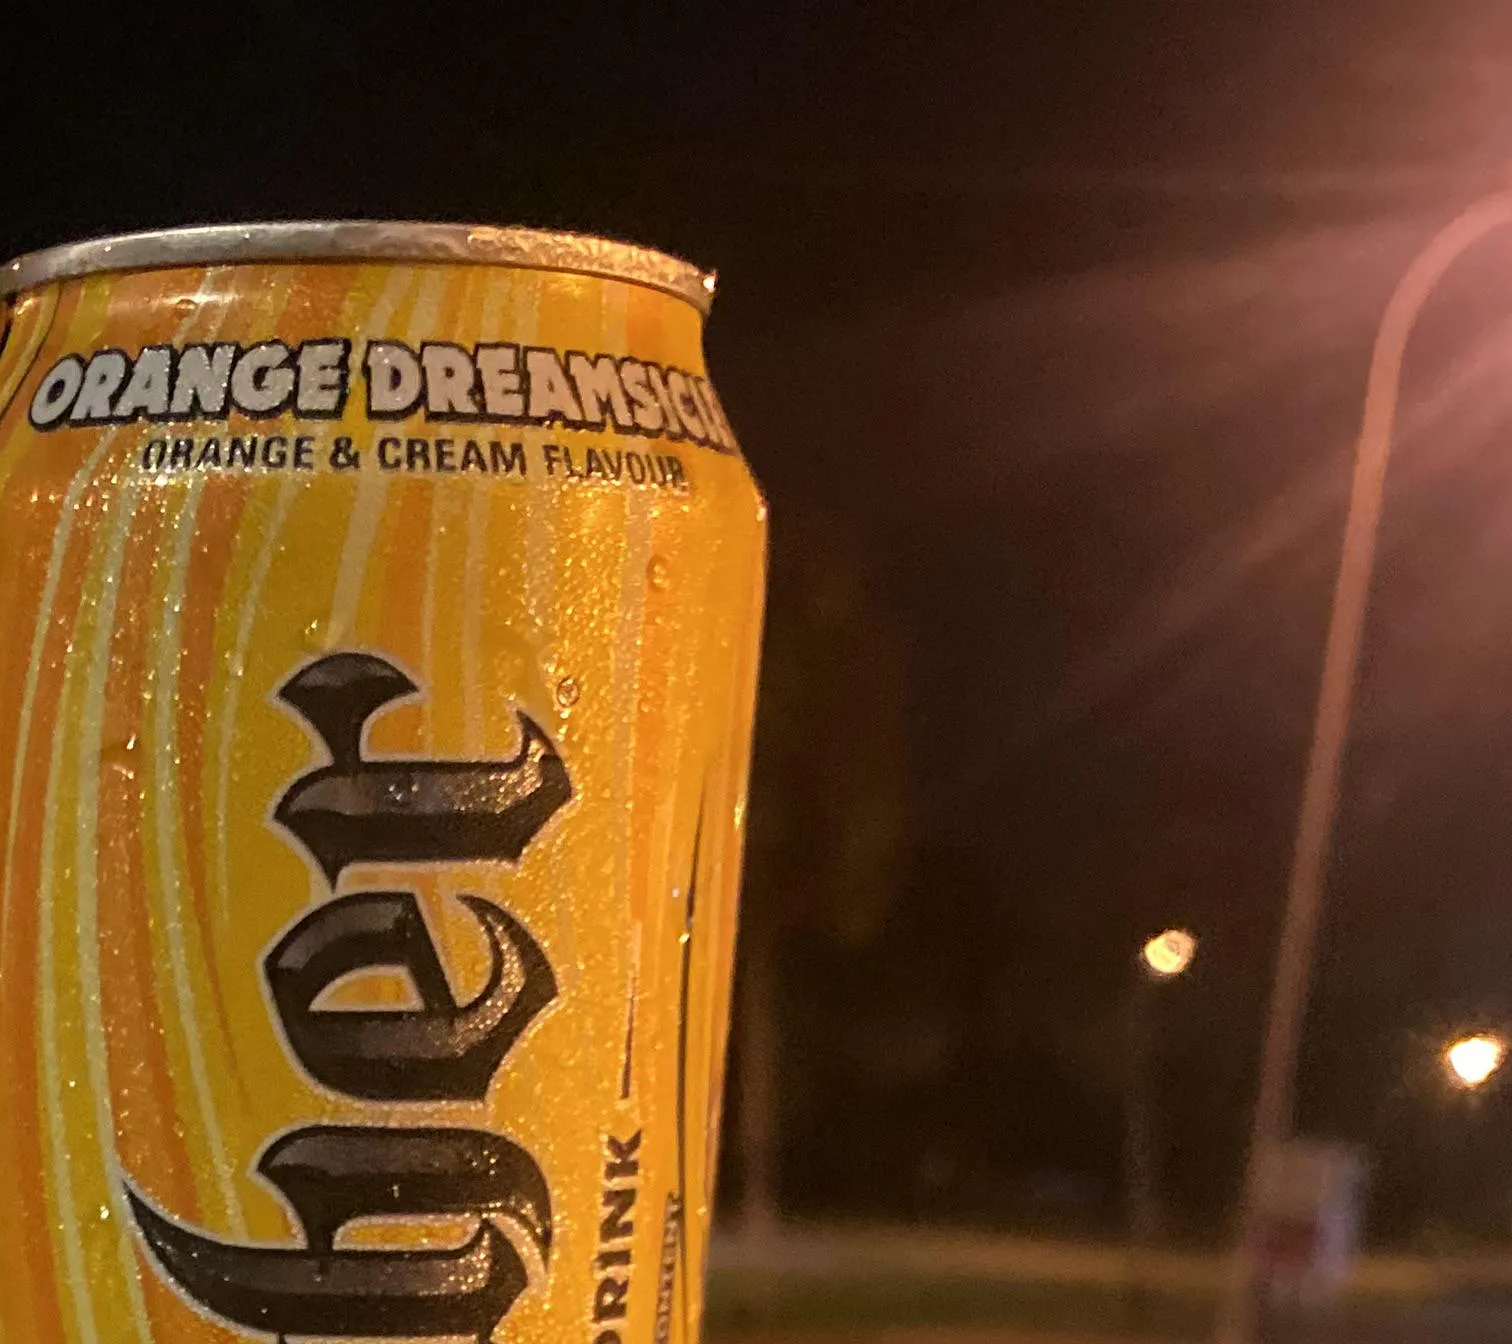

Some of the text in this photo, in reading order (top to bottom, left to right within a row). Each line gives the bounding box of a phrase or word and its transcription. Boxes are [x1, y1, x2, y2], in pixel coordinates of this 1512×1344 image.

[28, 338, 351, 431] ORANGE
[142, 436, 685, 489] ORANGE & CREAM FLAVOUR
